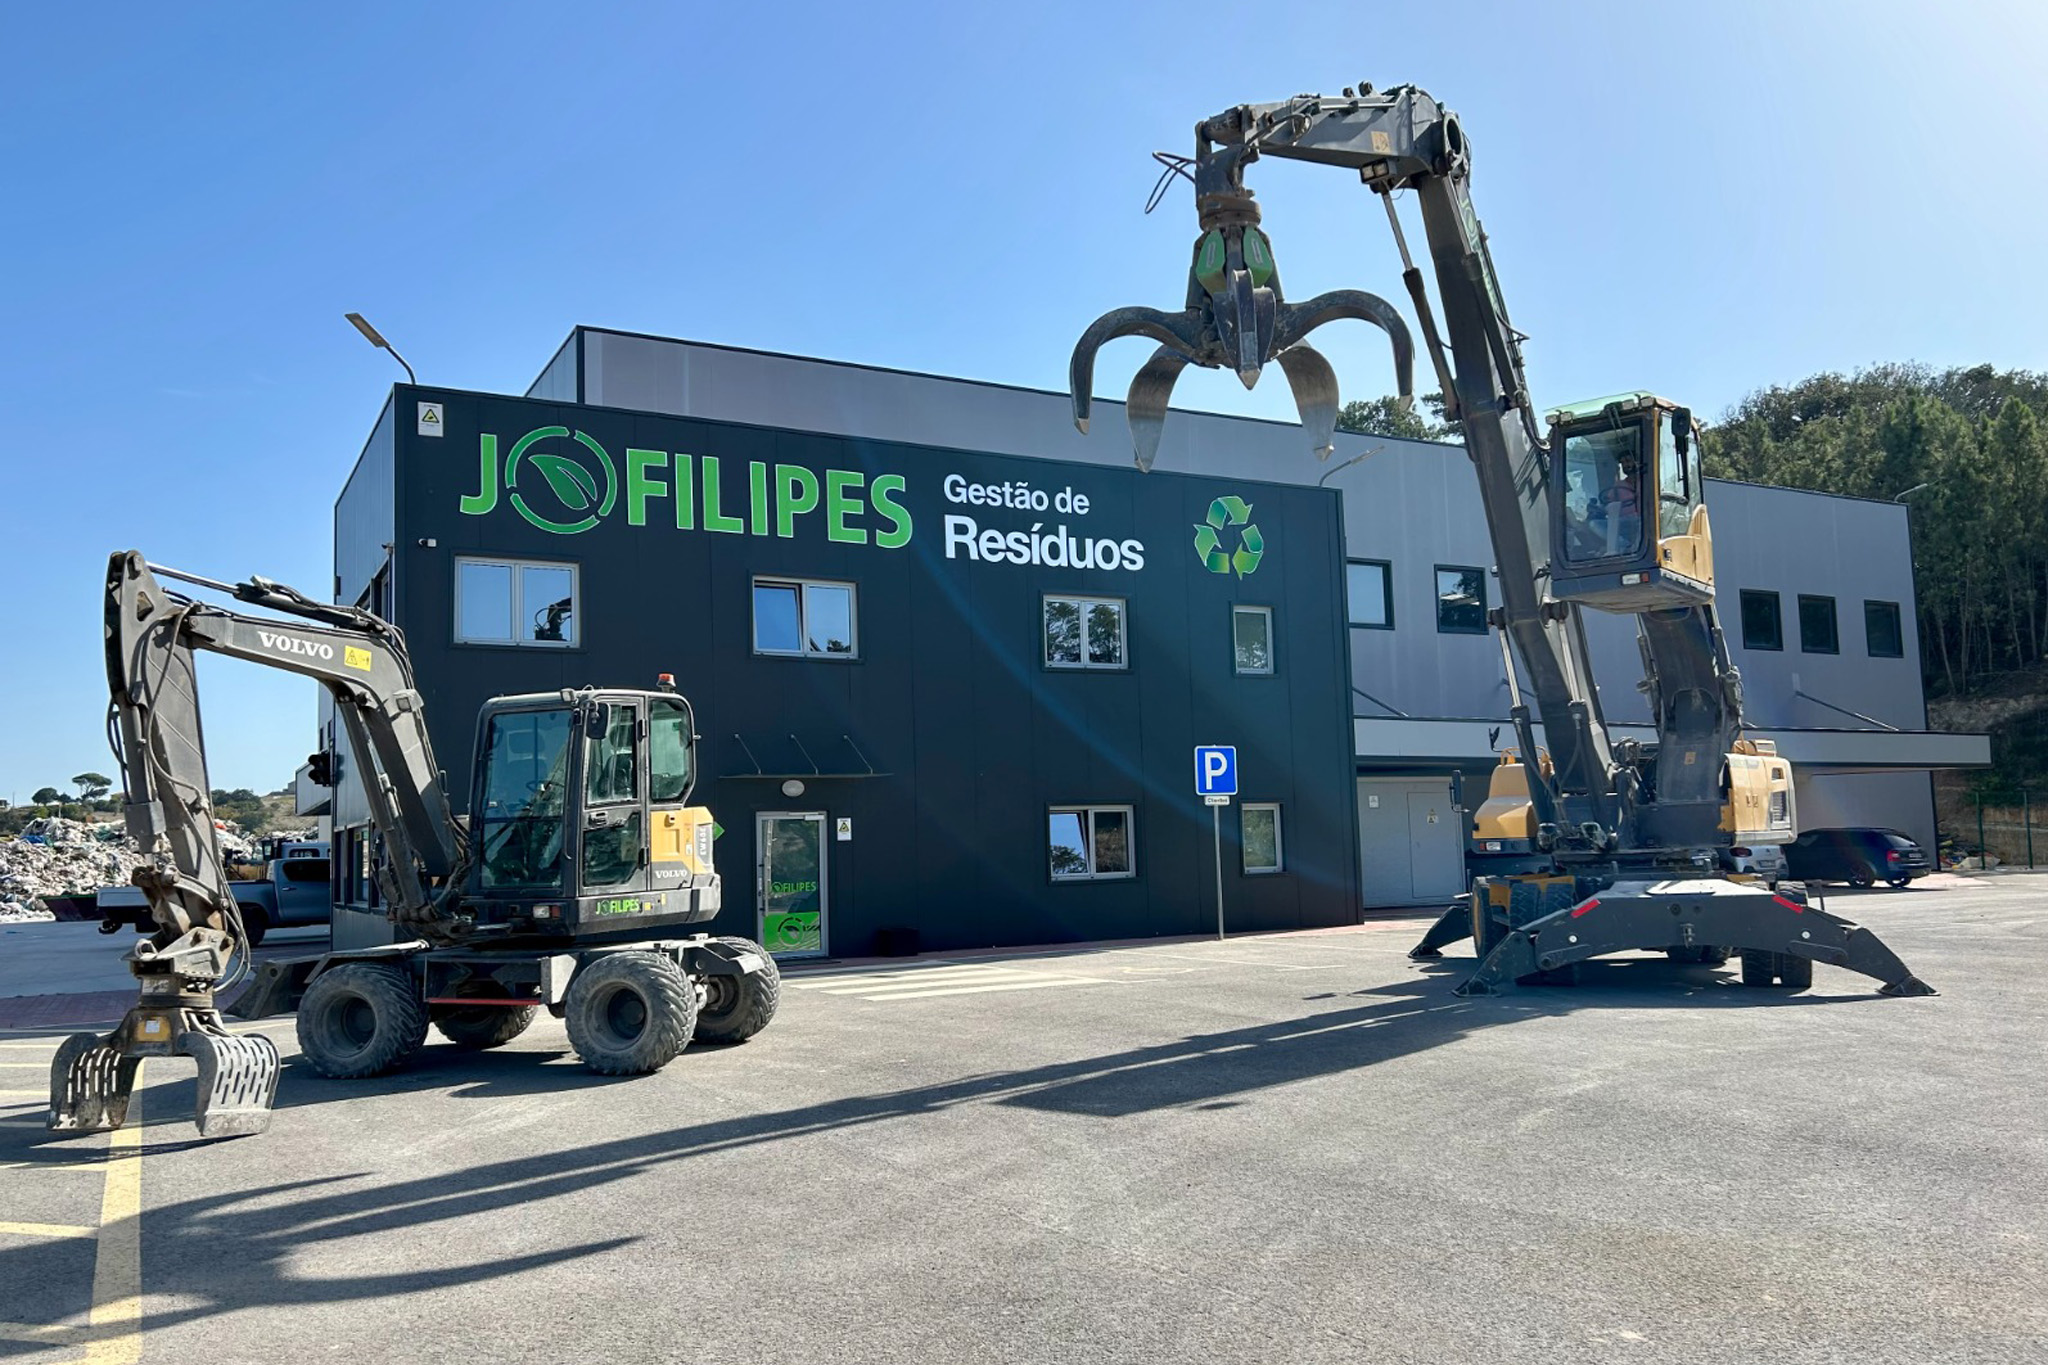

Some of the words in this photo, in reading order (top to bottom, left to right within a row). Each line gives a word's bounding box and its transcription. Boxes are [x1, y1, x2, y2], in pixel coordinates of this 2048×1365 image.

[943, 473, 1049, 511] Gestão
[1054, 486, 1090, 515] de
[944, 514, 1145, 571] Resíduos
[257, 631, 334, 660] VOLVO
[1205, 751, 1228, 790] P
[655, 869, 688, 879] VOLVO
